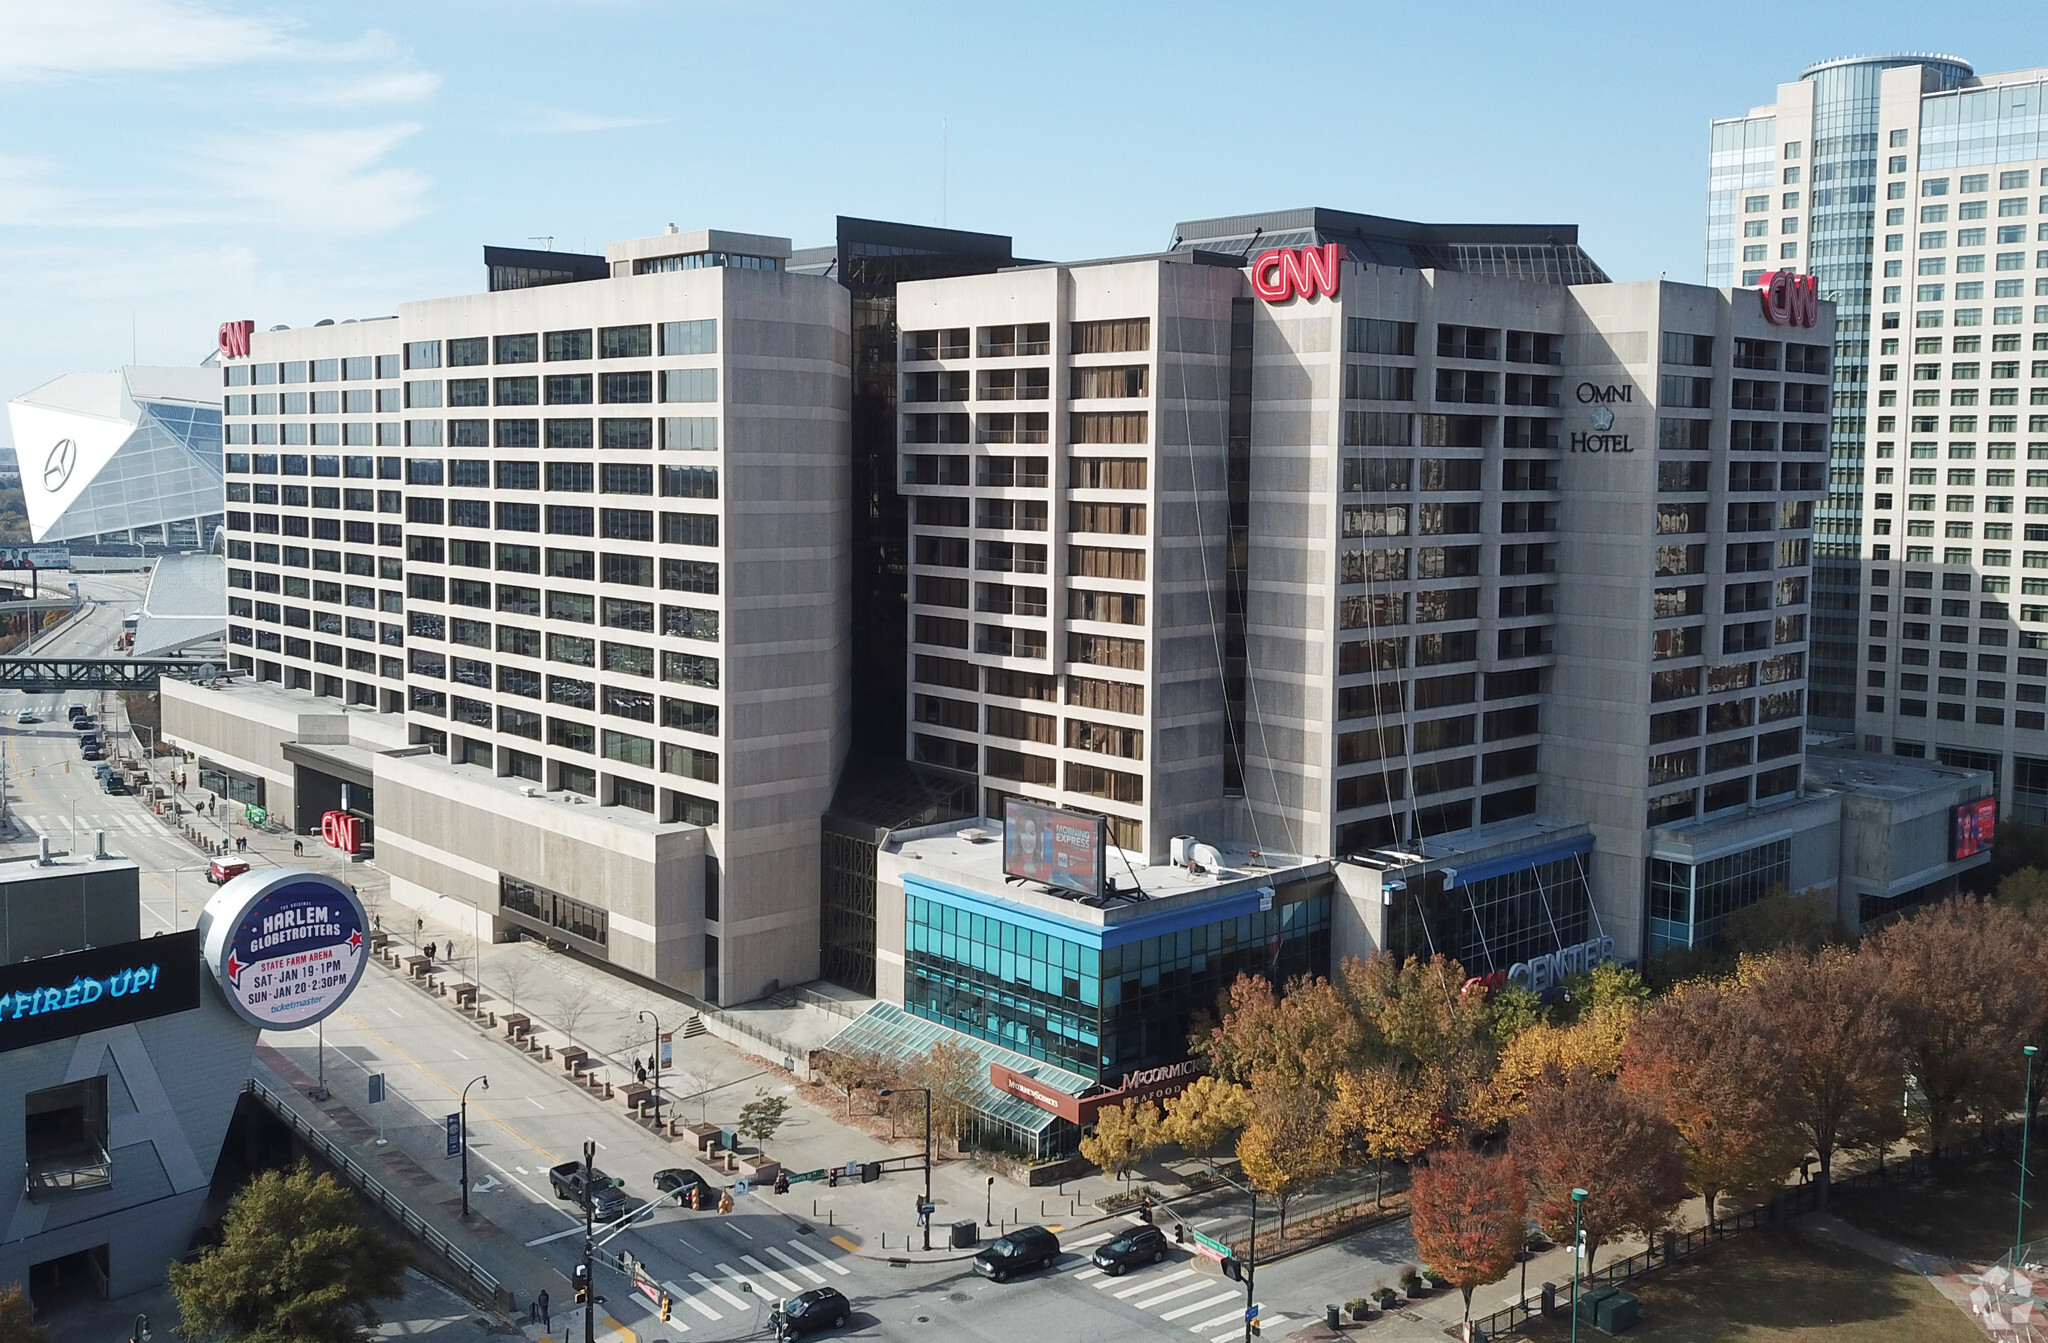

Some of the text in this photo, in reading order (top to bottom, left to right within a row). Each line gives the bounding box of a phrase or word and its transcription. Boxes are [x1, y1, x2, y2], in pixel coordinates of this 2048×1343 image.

[1251, 243, 1343, 302] CNN
[1763, 269, 1819, 328] CNN
[219, 320, 252, 358] CNN
[1576, 382, 1632, 403] OMNI
[1570, 432, 1634, 453] HOTEL
[321, 811, 361, 854] CNN
[1056, 824, 1091, 840] MORNING
[1056, 832, 1091, 849] EXPRESS
[263, 906, 328, 935] HARLEM
[250, 923, 341, 953] GLOBETROTTERS
[261, 950, 333, 972] STATE FARM ARENA
[1508, 935, 1615, 992] CENTER
[12, 977, 103, 1019] FIRED
[110, 965, 159, 998] UP!
[271, 995, 324, 1014] ticketmaster
[1127, 1085, 1182, 1105] EAFOOD
